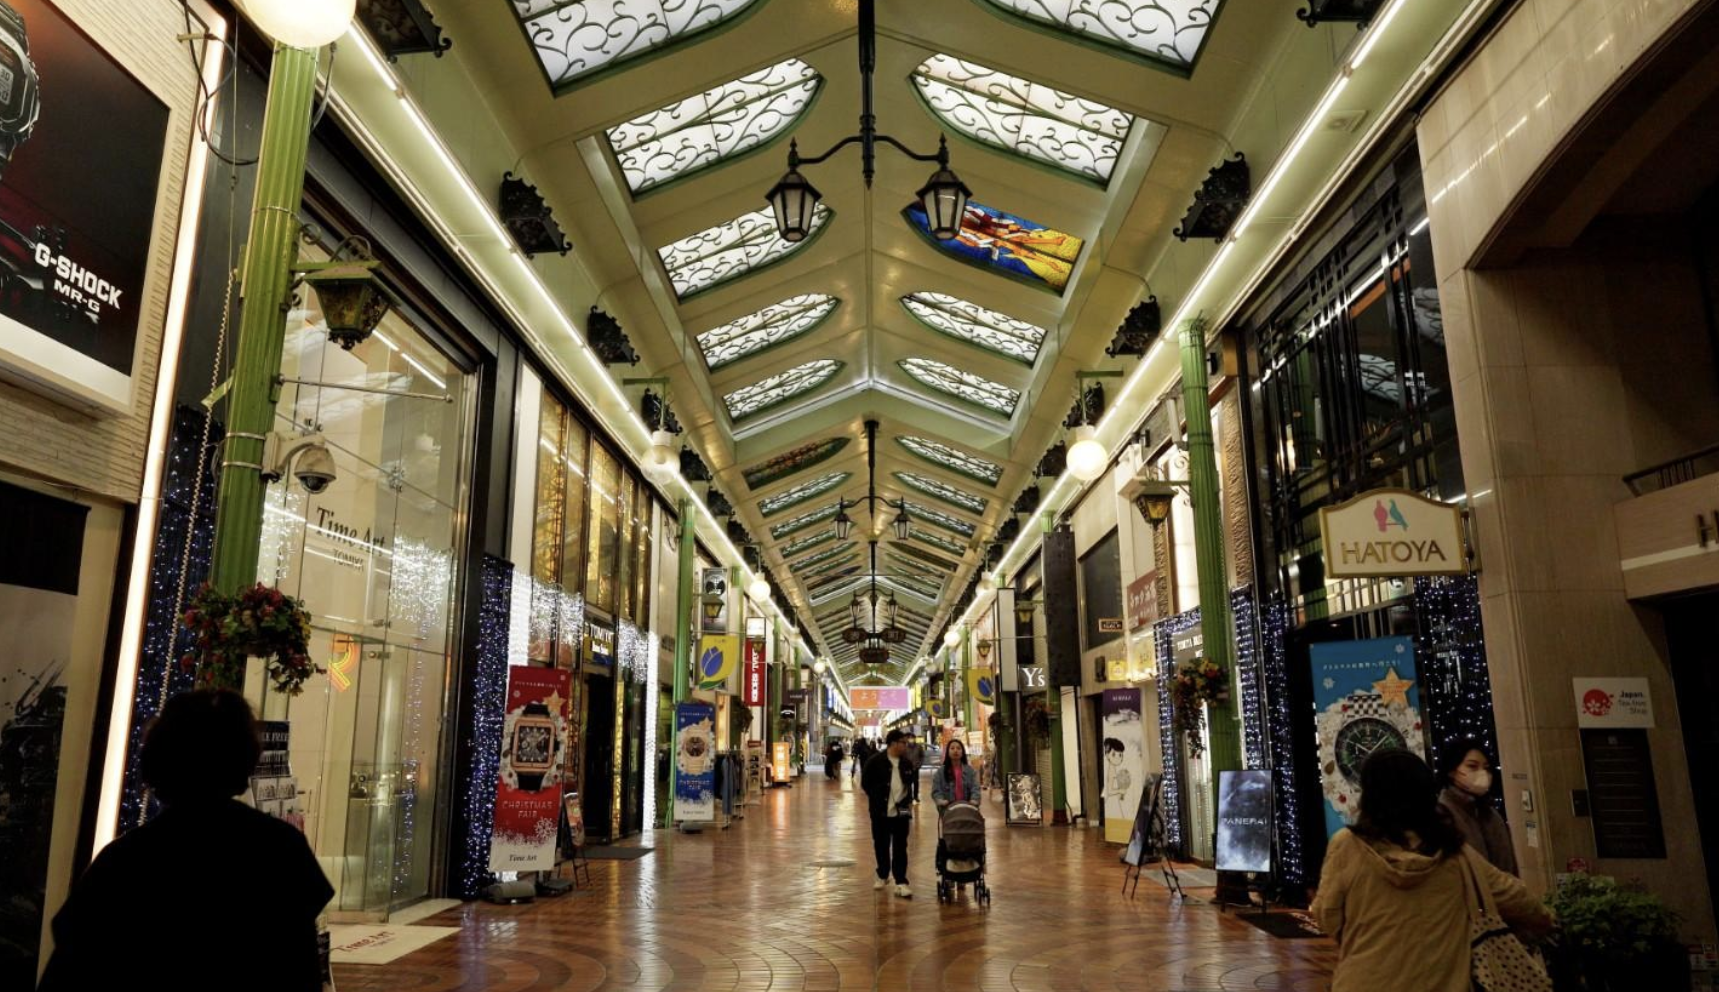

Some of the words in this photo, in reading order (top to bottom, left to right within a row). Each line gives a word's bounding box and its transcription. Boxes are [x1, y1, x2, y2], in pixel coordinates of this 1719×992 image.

[35, 242, 124, 310] G-SHOCK
[54, 278, 101, 313] MR-G
[316, 506, 357, 547] Time
[359, 527, 386, 557] Art
[1340, 539, 1447, 565] HATOYA
[1022, 667, 1046, 687] Y's
[502, 800, 553, 810] CHRISTMAS
[518, 810, 538, 818] FAIR
[1221, 816, 1268, 826] PANERAI
